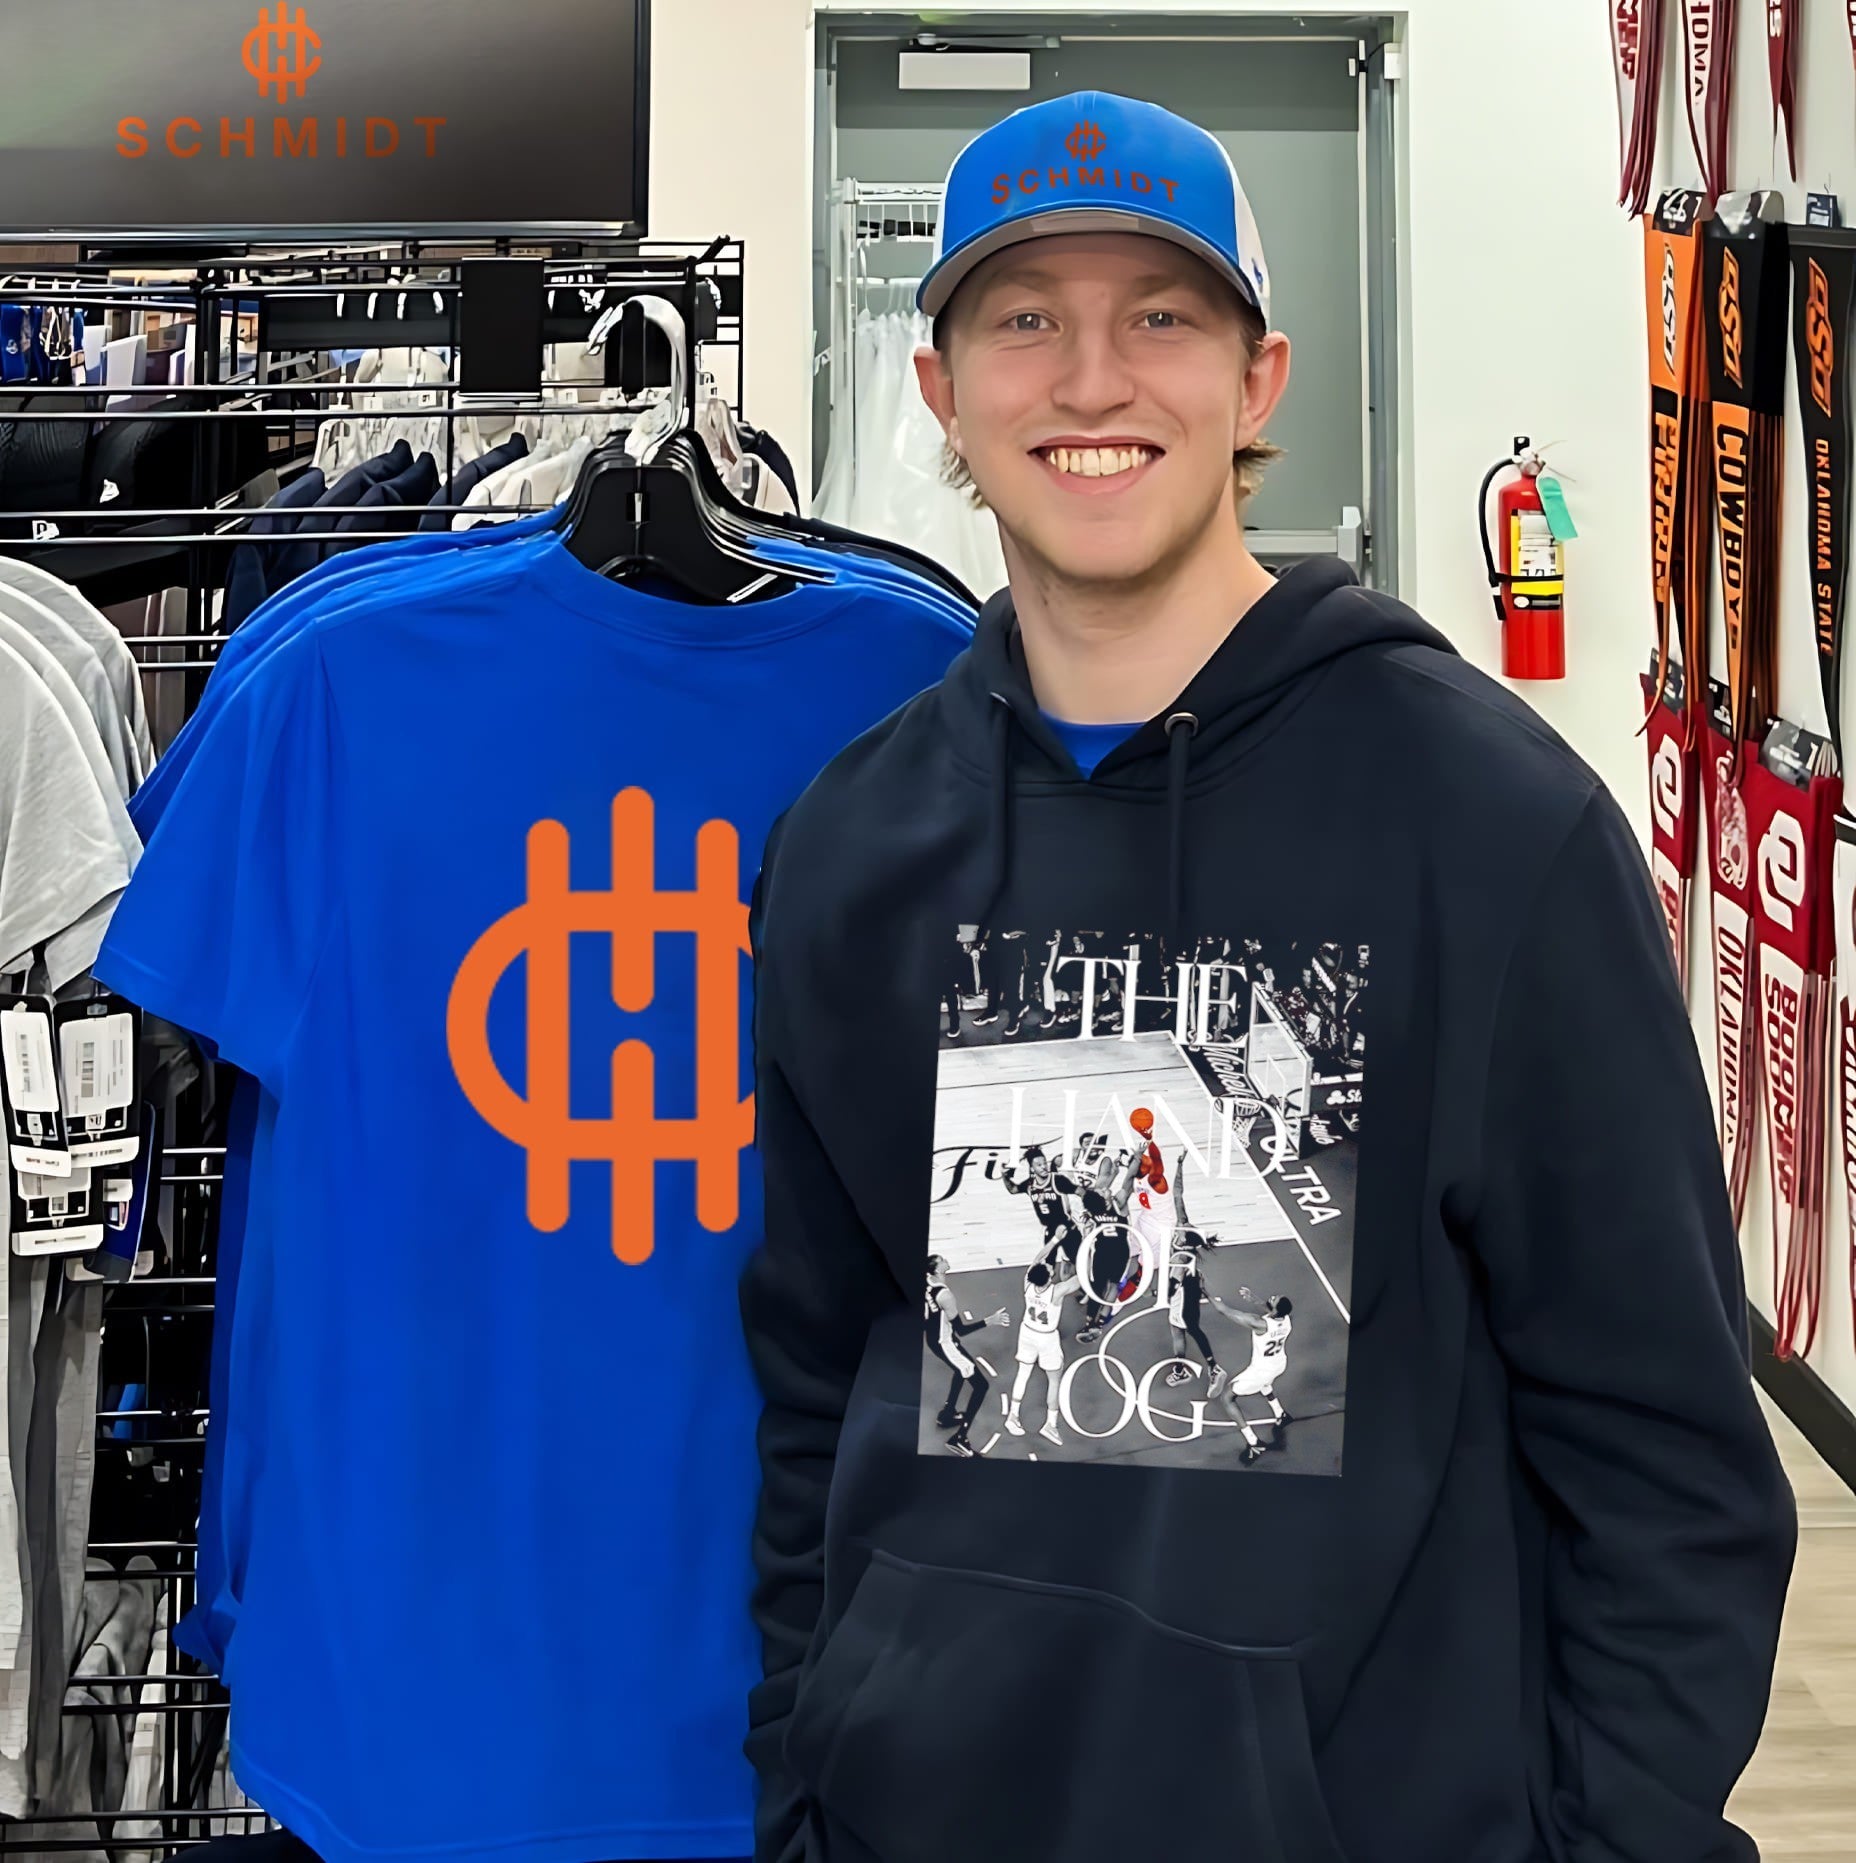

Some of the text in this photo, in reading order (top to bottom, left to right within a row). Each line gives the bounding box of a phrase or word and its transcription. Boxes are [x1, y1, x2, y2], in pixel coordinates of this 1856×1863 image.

[116, 117, 447, 159] SCHMIDT
[991, 166, 1179, 204] SCHMIDT
[1056, 956, 1247, 1048] THE
[1718, 926, 1746, 1144] OKLAHOMA
[1202, 1045, 1259, 1099] Michel
[1009, 1086, 1289, 1181] HAND
[1076, 1223, 1205, 1311] OF
[1059, 1354, 1209, 1443] OG
